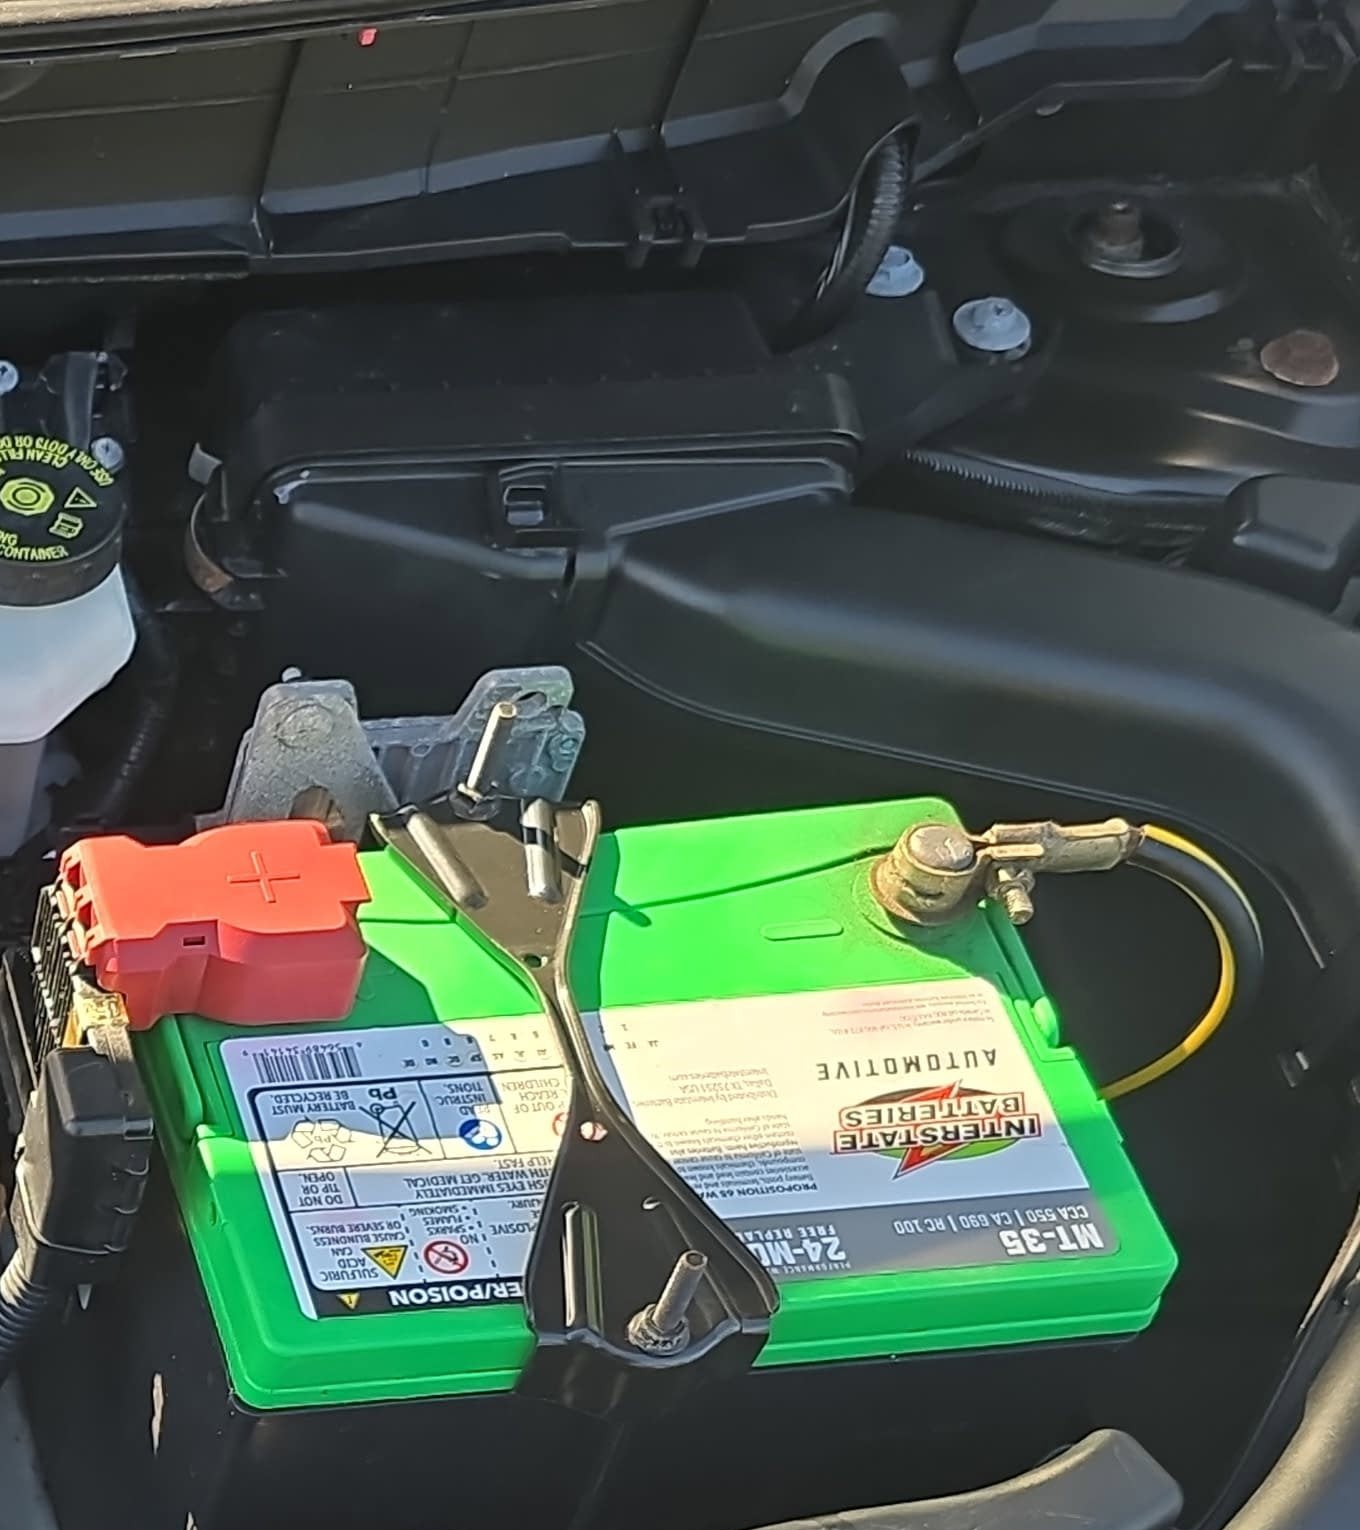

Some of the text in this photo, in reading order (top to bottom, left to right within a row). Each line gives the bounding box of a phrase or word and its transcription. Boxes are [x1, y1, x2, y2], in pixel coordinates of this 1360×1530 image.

[15, 435, 33, 447] OR
[26, 450, 68, 468] CLEAN
[815, 1048, 996, 1080] AUTOMOTIVE
[444, 1082, 484, 1094] TIONS.
[501, 1078, 560, 1091] CHILDREN
[270, 1090, 349, 1103] BE RECYCLED.
[368, 1087, 397, 1101] Pb
[272, 1100, 355, 1115] BATTERY MUST
[845, 1097, 1020, 1129] BATTERIES
[838, 1116, 1039, 1152] INTERSTATE
[493, 1158, 524, 1169] FAST.
[298, 1172, 335, 1182] OPEN.
[458, 1173, 480, 1185] GET
[528, 1168, 551, 1180] ITH
[403, 1175, 456, 1188] MEDICAL
[496, 1181, 524, 1194] EYES
[301, 1183, 341, 1195] TIP OR
[416, 1184, 495, 1199] IMMEDIATELY
[718, 1189, 734, 1197] 65
[736, 1183, 818, 1196] PROPOSITION
[298, 1195, 343, 1207] DO NOT
[408, 1204, 459, 1216] SMOKING
[422, 1215, 463, 1225] FLAMES
[893, 1204, 1089, 1235] CCA 550 CA 690 RC 100
[305, 1220, 402, 1235] OR SEVERE BURNS.
[426, 1225, 466, 1235] SPARKS
[788, 1223, 837, 1238] FREE
[313, 1232, 405, 1246] CAUSE BLINDNESS
[460, 1234, 479, 1244] NO
[999, 1221, 1105, 1256] MT-35
[330, 1247, 353, 1256] CAN
[337, 1258, 366, 1268] ACID
[319, 1268, 379, 1282] SULFURIC
[388, 1282, 522, 1306] ER/POISON
